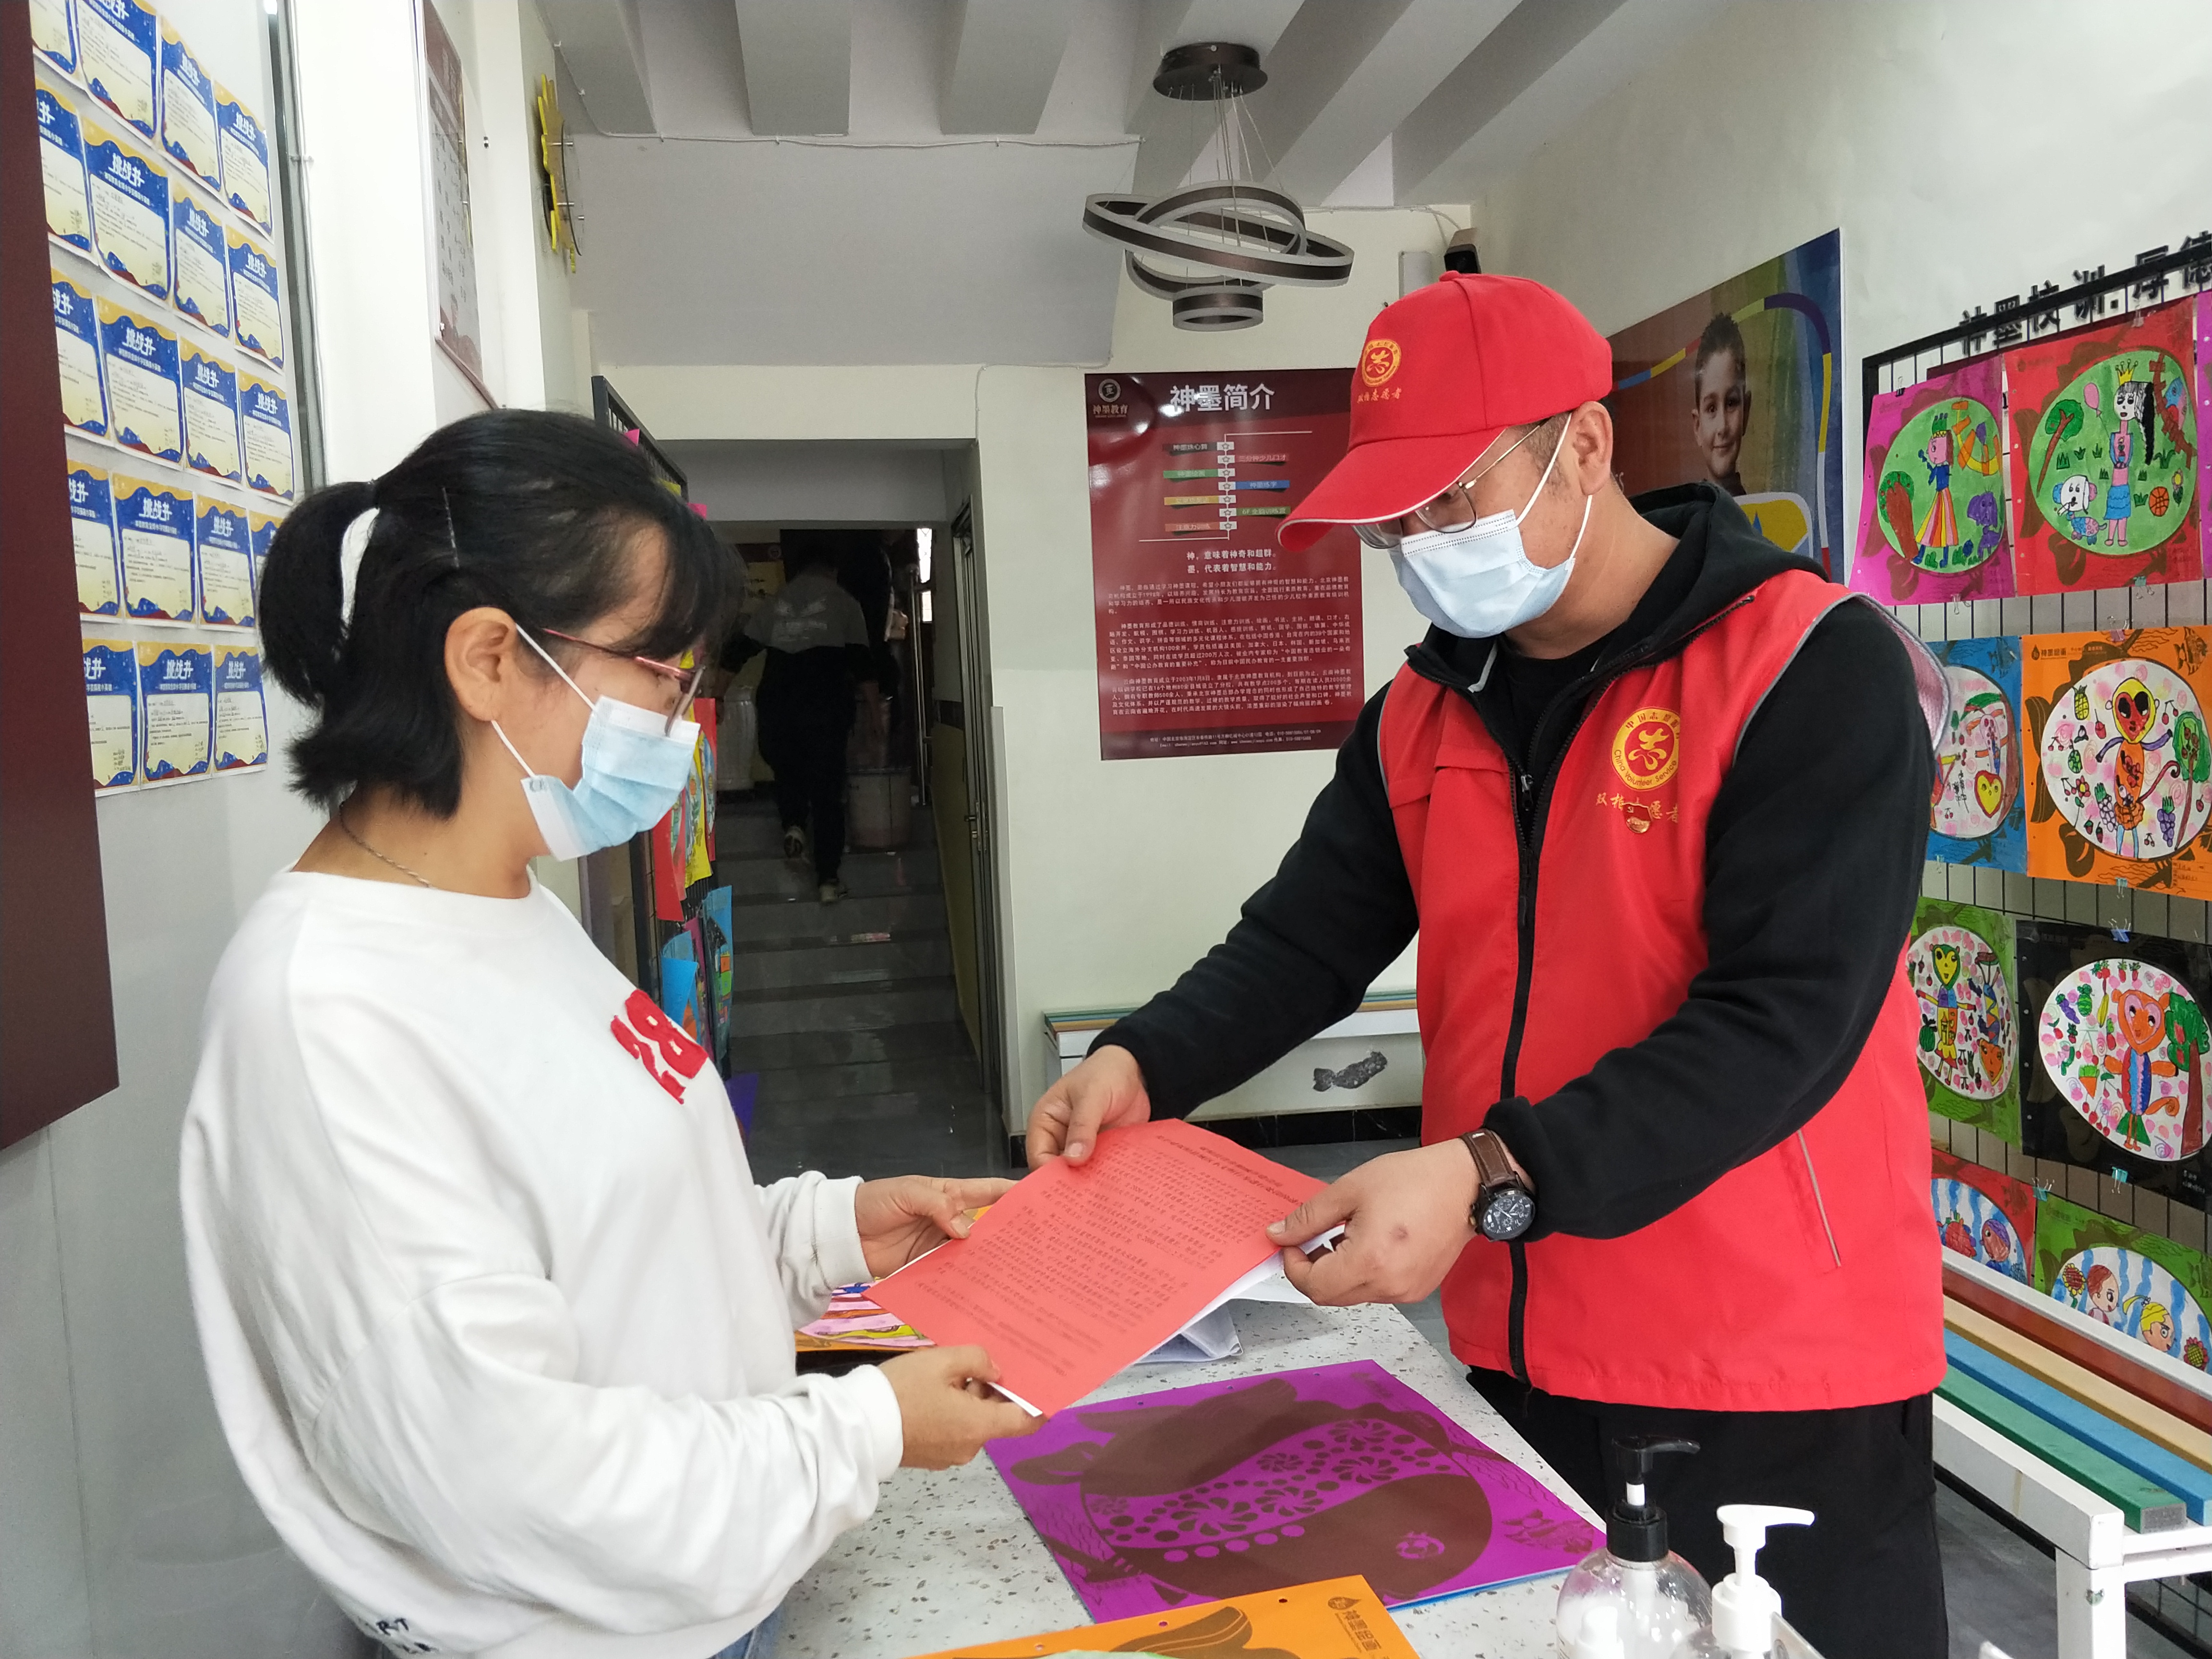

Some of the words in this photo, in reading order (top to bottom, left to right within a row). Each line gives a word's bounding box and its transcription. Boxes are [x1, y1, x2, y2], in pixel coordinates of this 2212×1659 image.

[108, 153, 145, 187] 挑战书
[122, 327, 156, 356] 挑战书
[195, 363, 219, 388] 挑战书
[255, 391, 278, 414] 挑战书
[1093, 404, 1129, 415] 神墨教育
[1170, 383, 1275, 412] 神墨简介
[138, 496, 173, 522] 挑战书
[211, 516, 234, 537] 挑战书
[163, 659, 194, 680] 挑战书
[226, 661, 247, 679] 挑战书
[1614, 749, 1626, 771] China
[1625, 770, 1652, 786] Volunteer
[1655, 760, 1677, 782] Service
